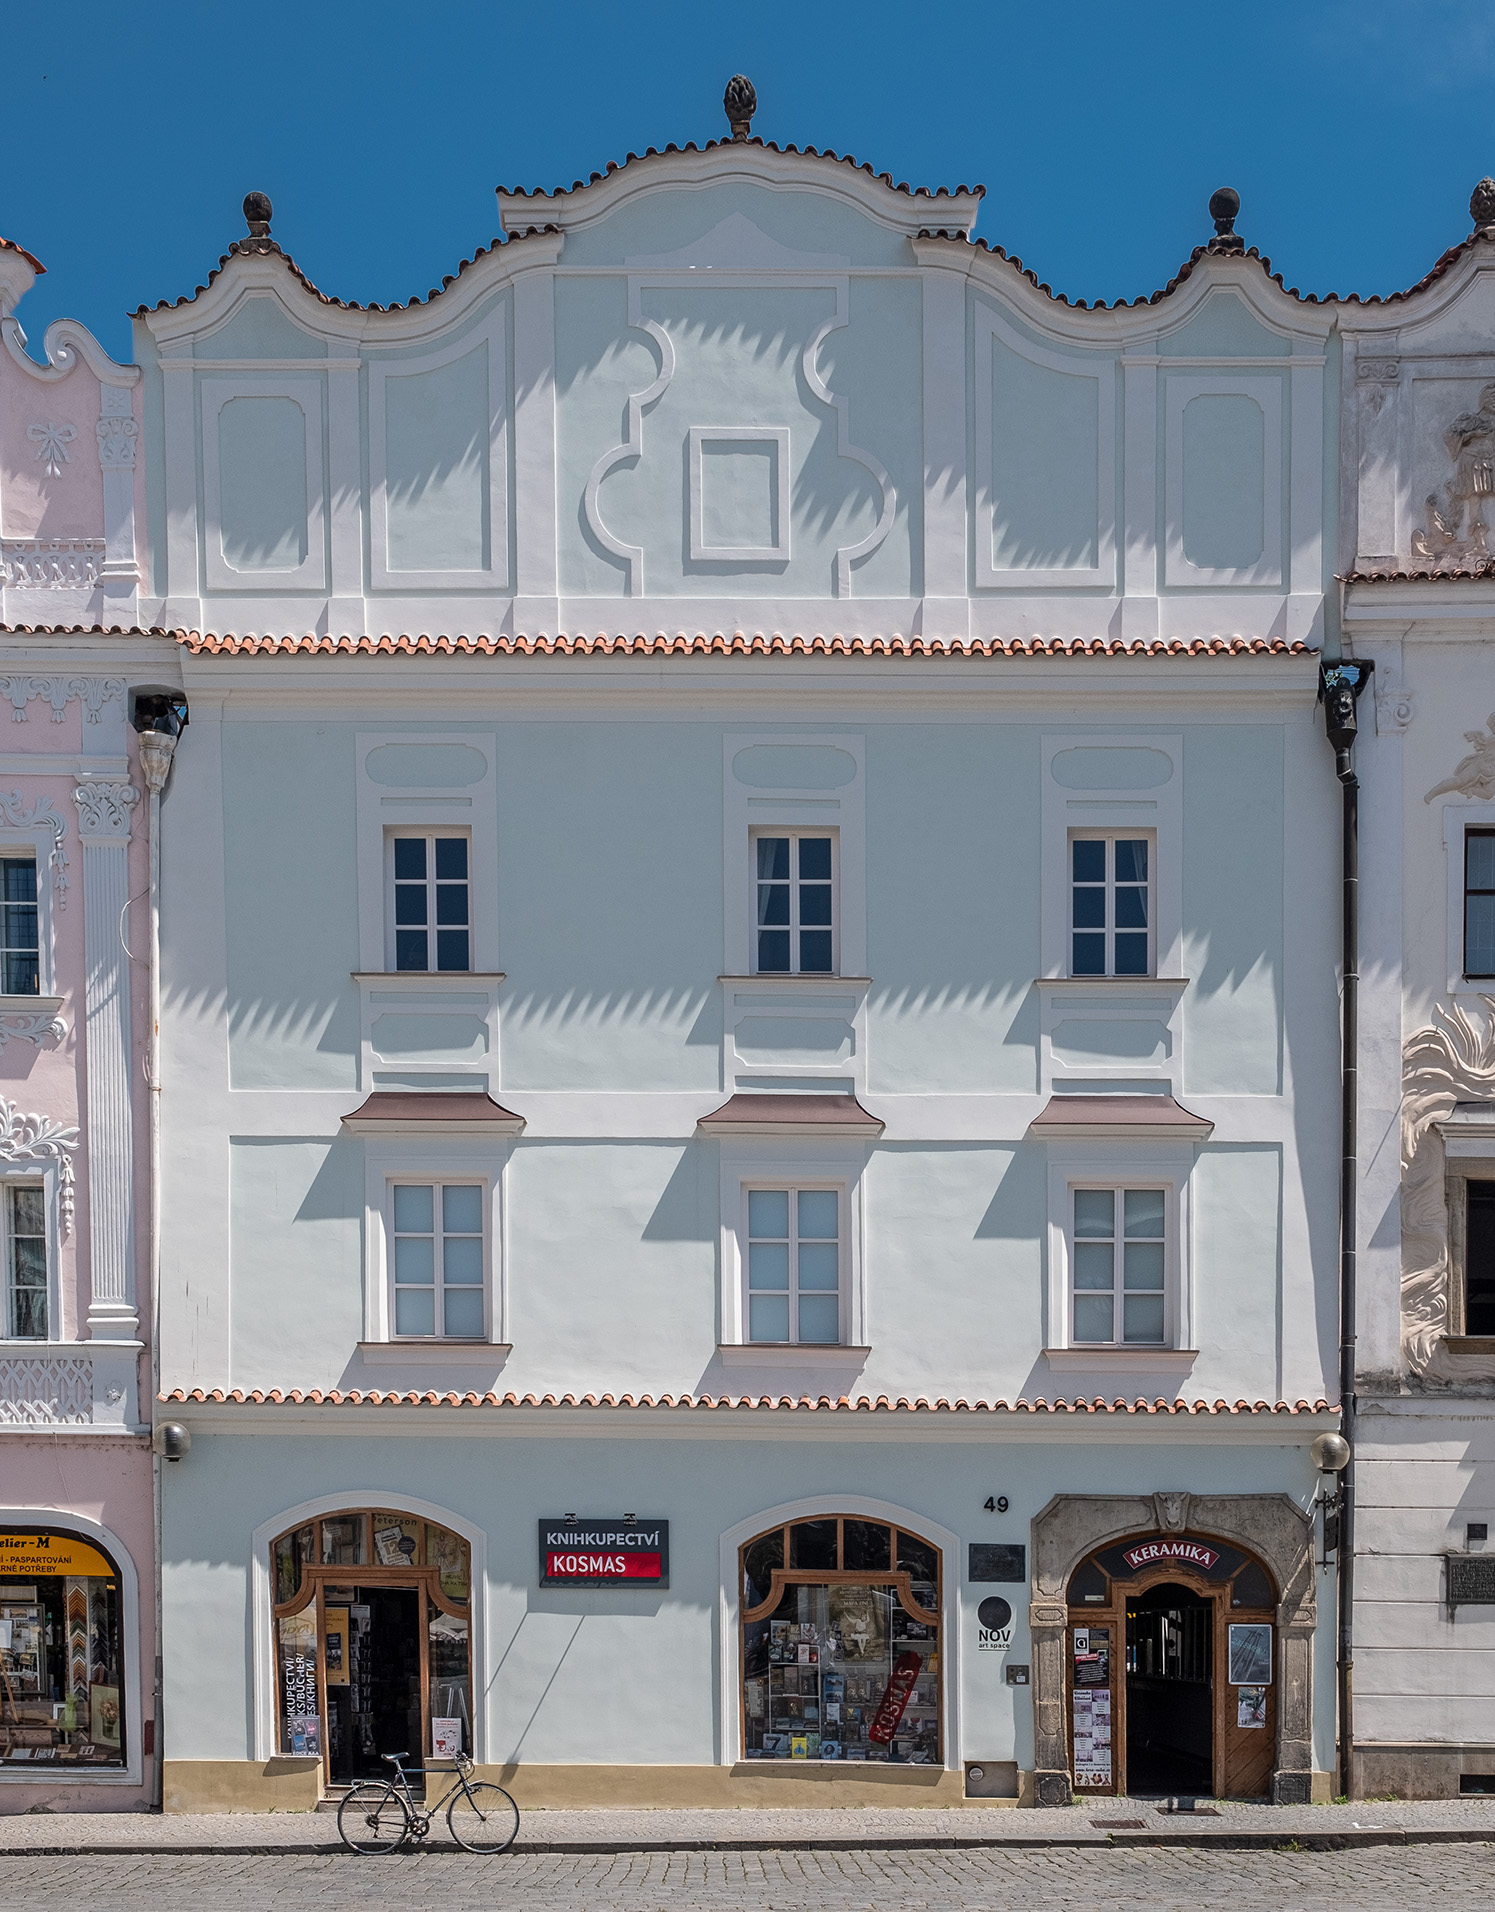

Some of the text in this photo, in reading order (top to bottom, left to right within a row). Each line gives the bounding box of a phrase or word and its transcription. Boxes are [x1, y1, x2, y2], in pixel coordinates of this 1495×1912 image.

[984, 1496, 1009, 1512] 49
[546, 1530, 660, 1546] KNIHKUPECTVÍ
[10, 1555, 72, 1564] PASPARTOVÁNÍ
[1130, 1543, 1211, 1565] KERAMIKA
[0, 1564, 57, 1573] RNÉ POTŘEBY
[553, 1555, 626, 1573] KOSMAS
[978, 1629, 1011, 1642] NOV
[875, 1667, 915, 1740] KOSMAS
